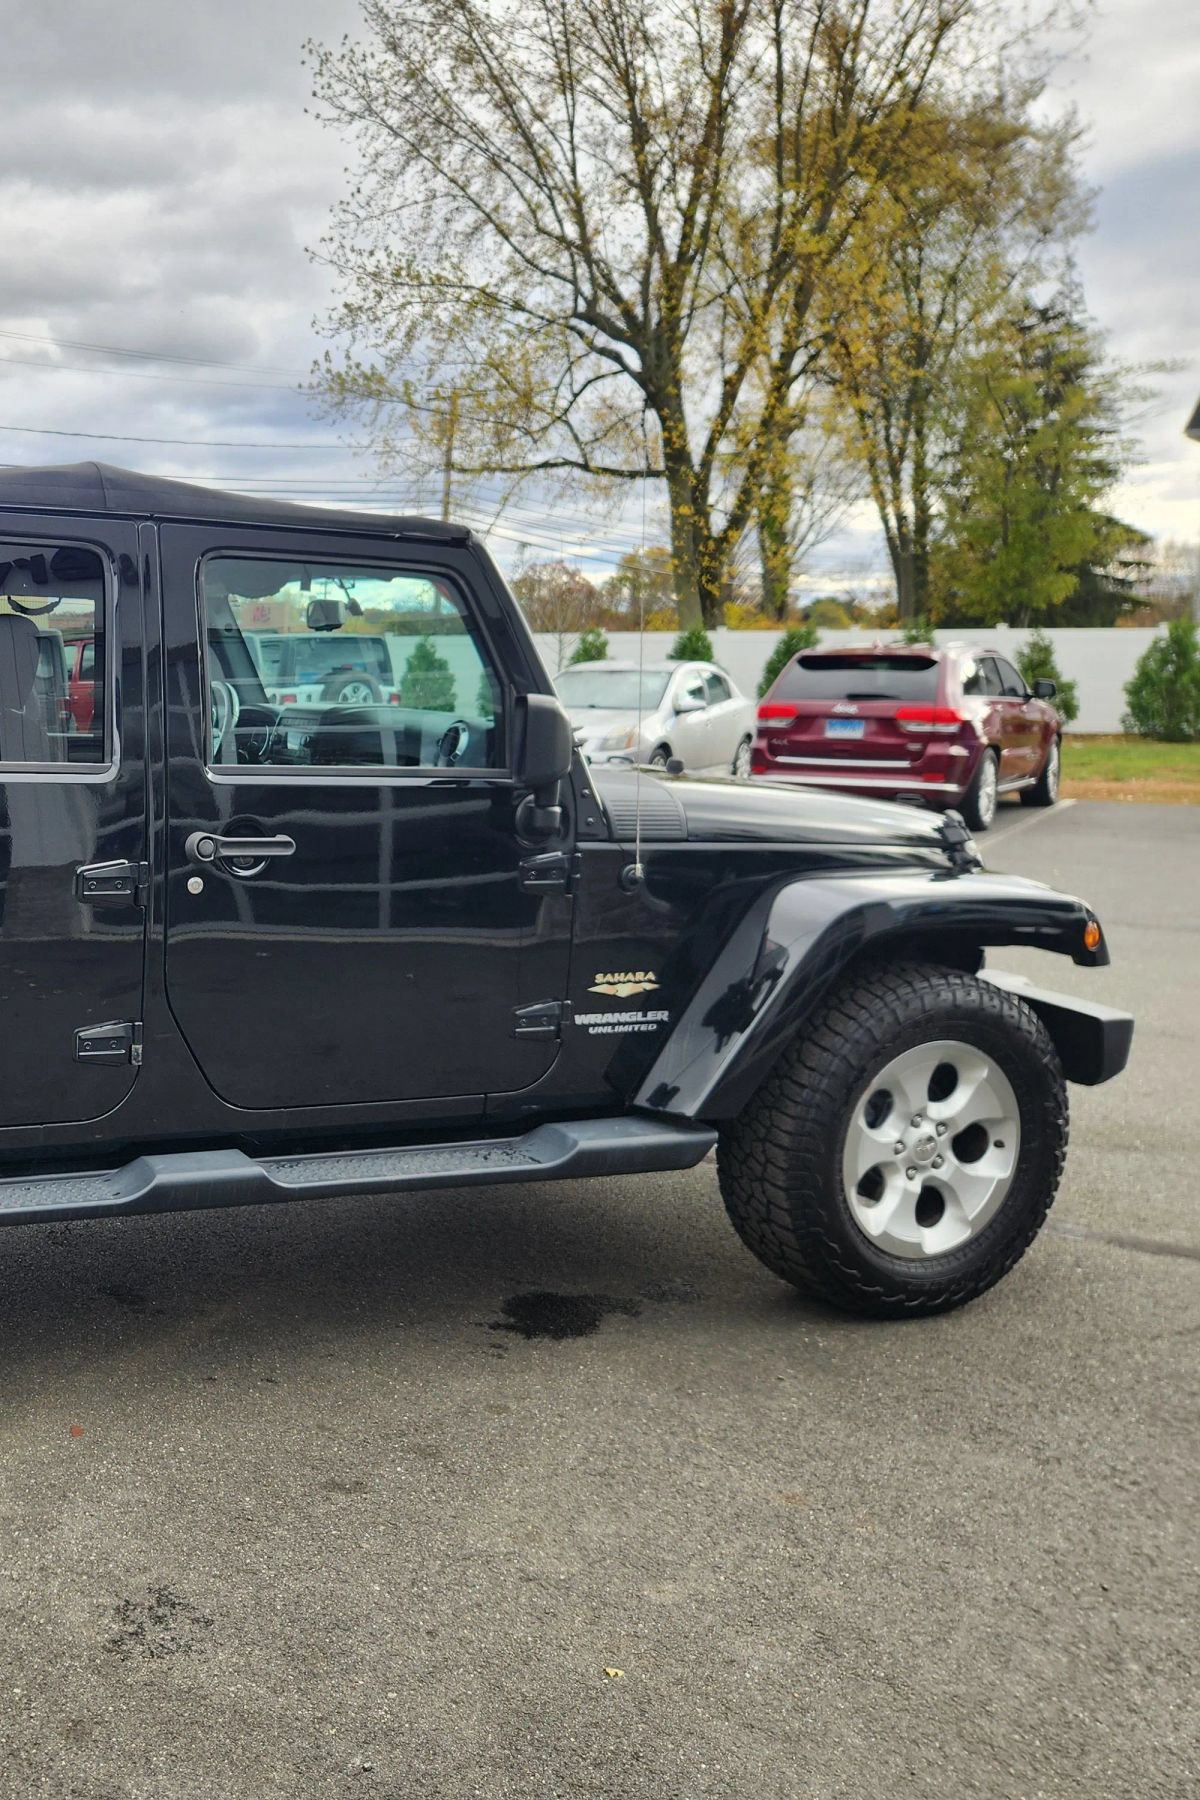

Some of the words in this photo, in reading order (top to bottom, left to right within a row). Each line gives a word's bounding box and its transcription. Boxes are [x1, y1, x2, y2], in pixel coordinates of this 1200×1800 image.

[594, 971, 656, 984] SAHARA
[574, 1010, 669, 1025] WRANGLER
[588, 1023, 657, 1034] UNLIMITED
